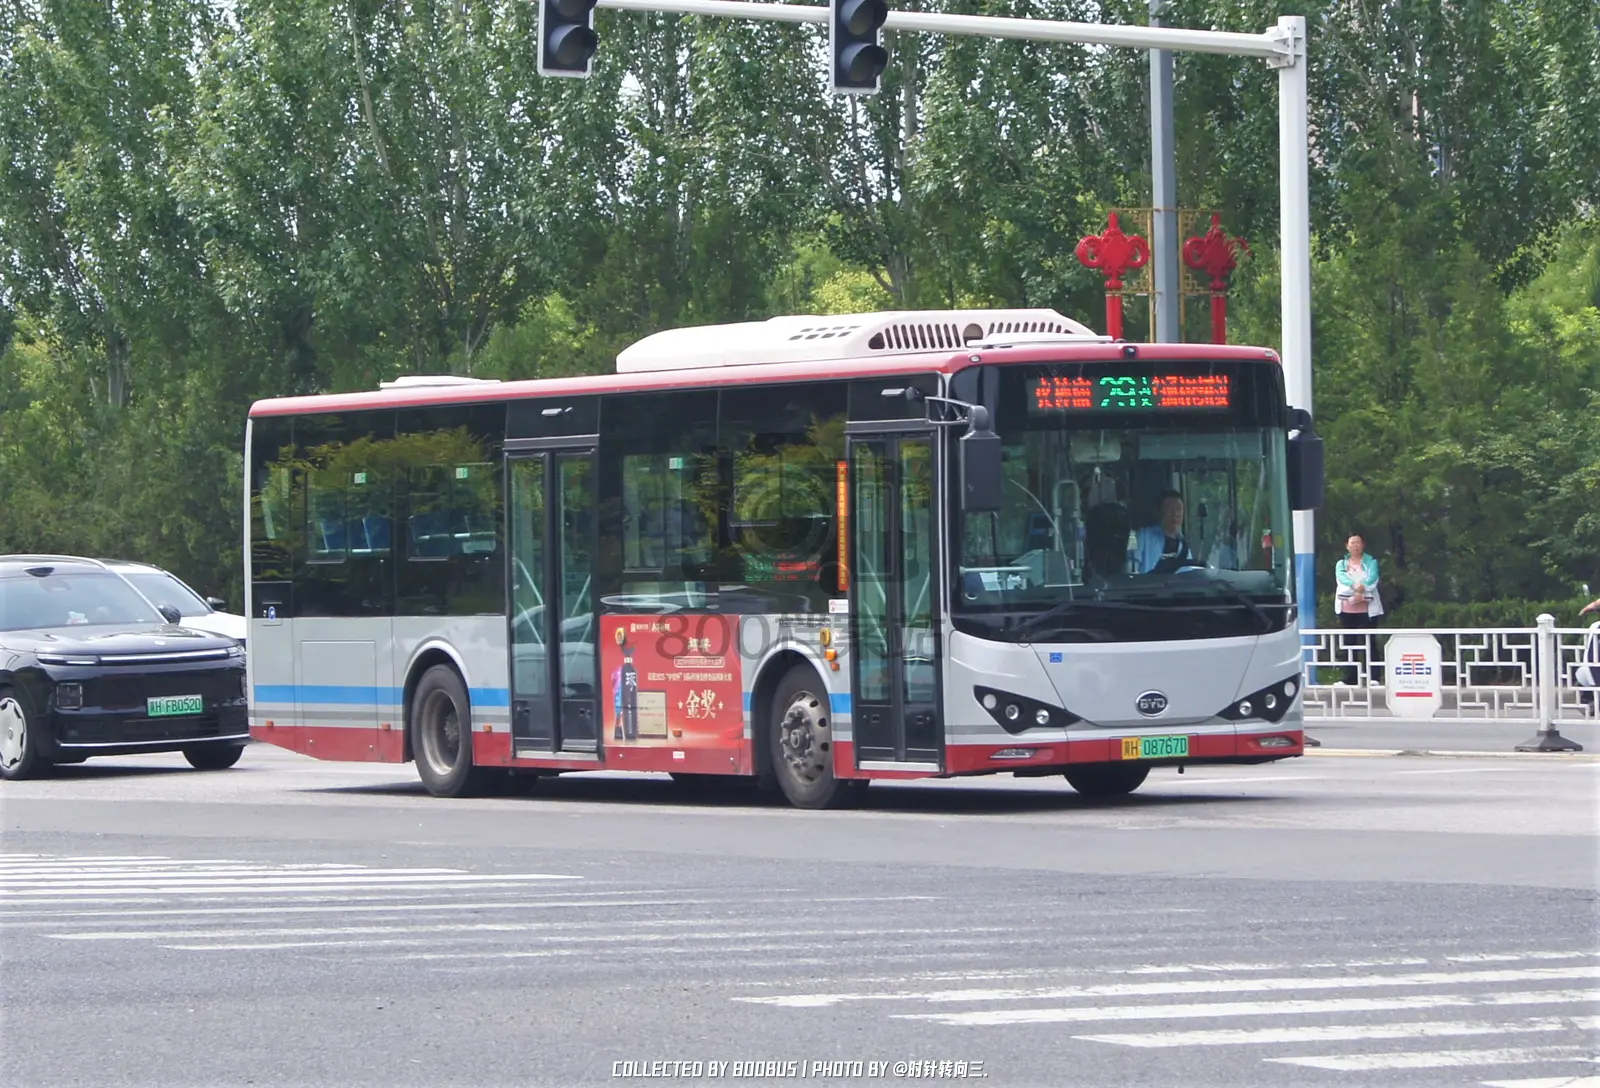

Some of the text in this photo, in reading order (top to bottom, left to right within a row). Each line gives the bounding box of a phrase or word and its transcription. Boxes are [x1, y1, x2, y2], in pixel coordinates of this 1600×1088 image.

[165, 697, 201, 713] FB0520
[685, 689, 716, 719] 金奖
[1140, 698, 1165, 709] BYD
[1143, 737, 1187, 756] 08767D
